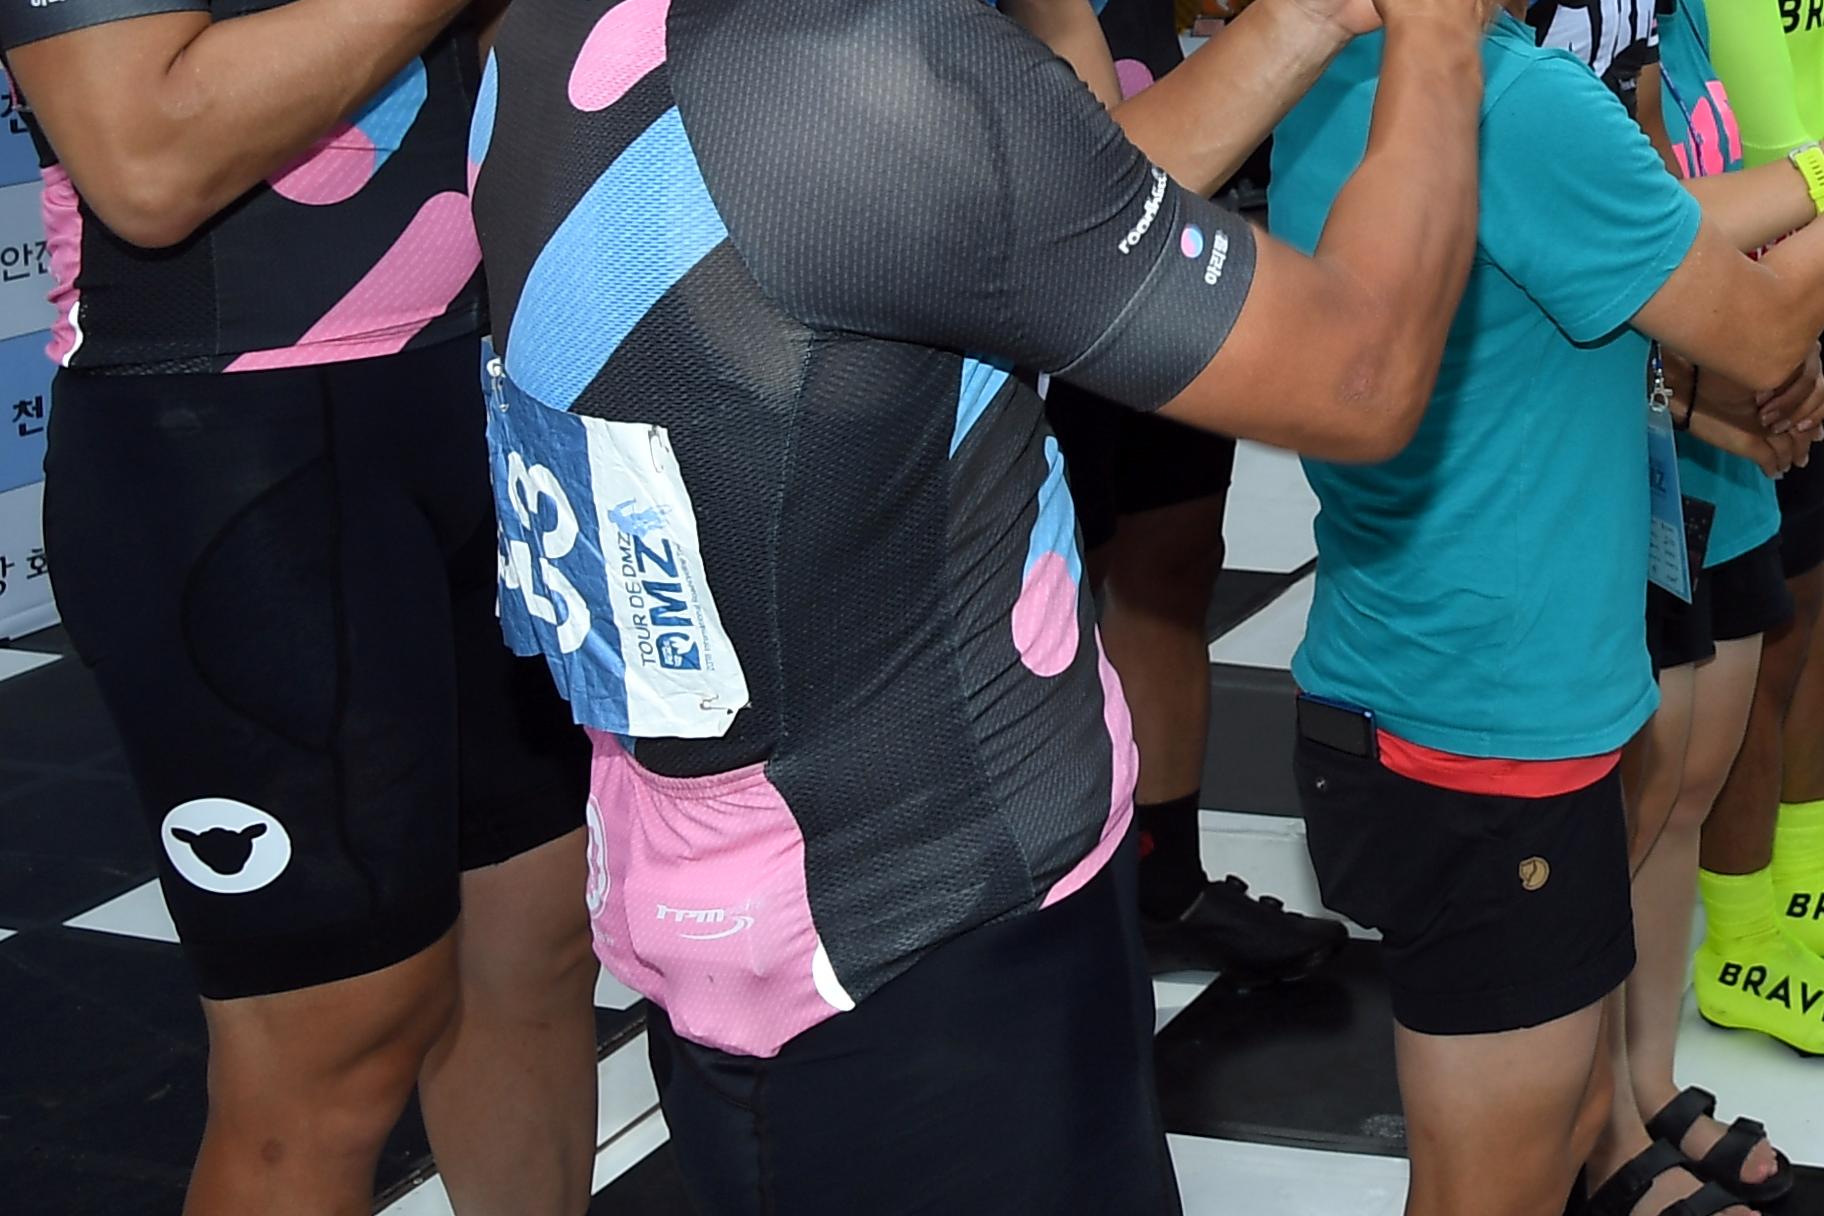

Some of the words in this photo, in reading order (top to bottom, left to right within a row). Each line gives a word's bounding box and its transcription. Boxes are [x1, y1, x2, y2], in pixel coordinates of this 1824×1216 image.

[617, 531, 638, 579] DMZ
[625, 581, 646, 611] DE
[632, 532, 702, 671] DMZ
[631, 614, 657, 668] TOUR
